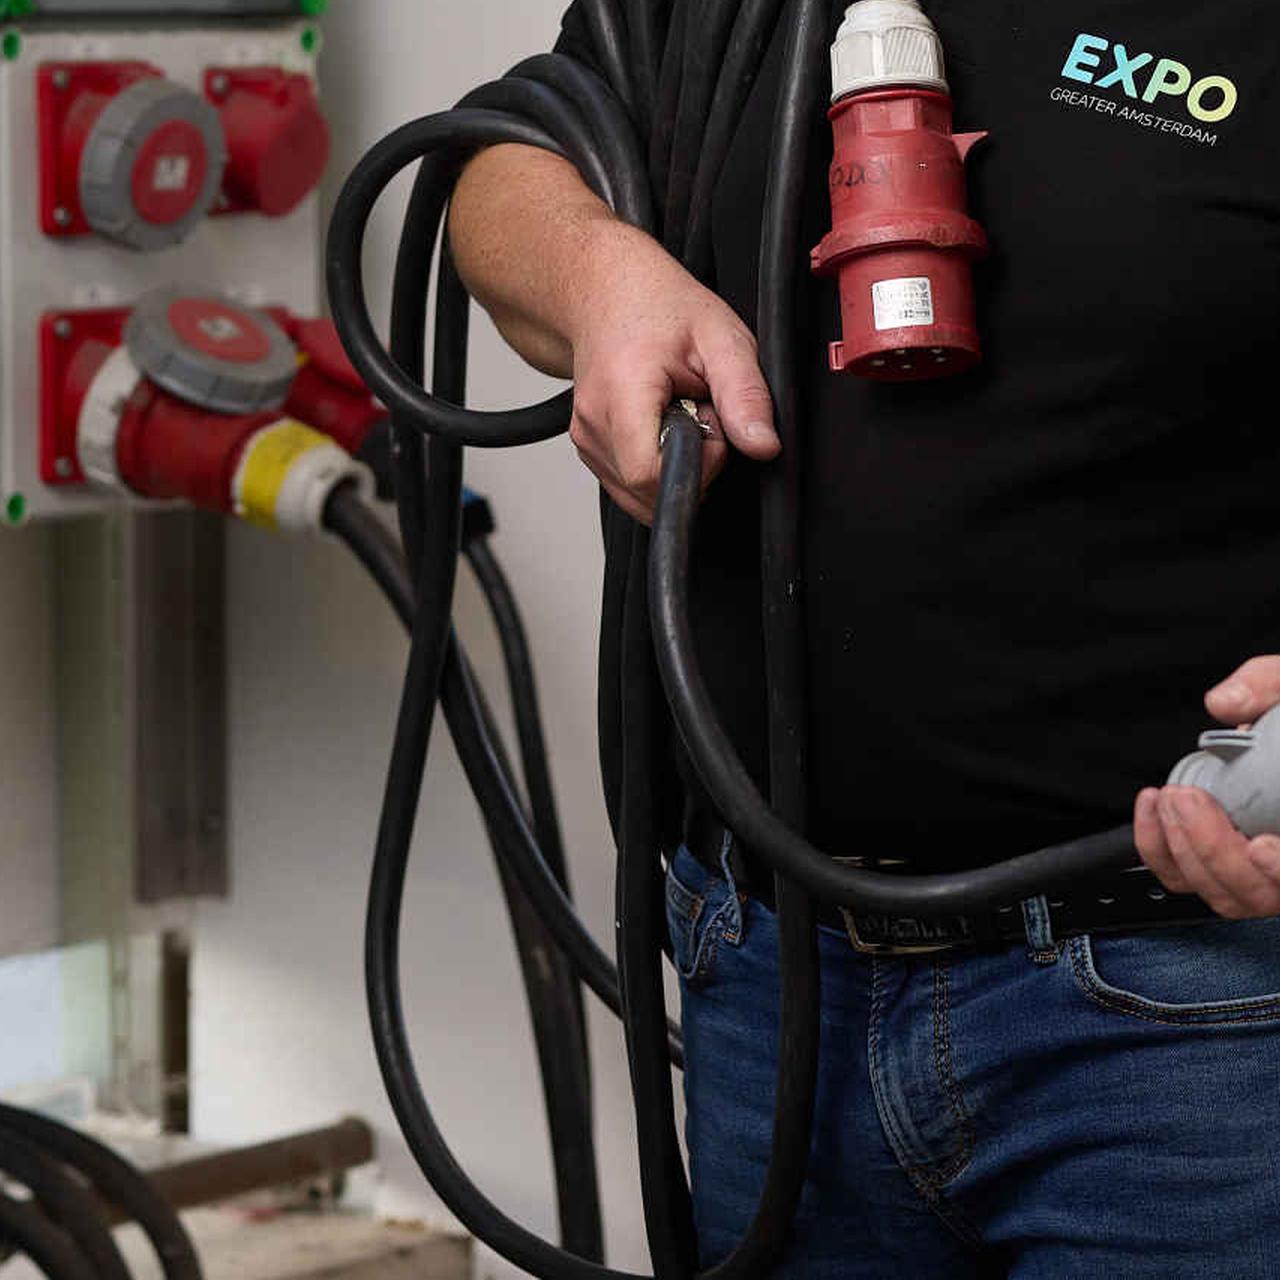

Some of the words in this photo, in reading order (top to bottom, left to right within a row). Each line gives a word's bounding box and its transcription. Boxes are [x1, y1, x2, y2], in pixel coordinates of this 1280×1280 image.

[1061, 33, 1238, 122] EXPO
[1050, 86, 1117, 115] GREATER
[1117, 106, 1218, 147] AMSTERDAM
